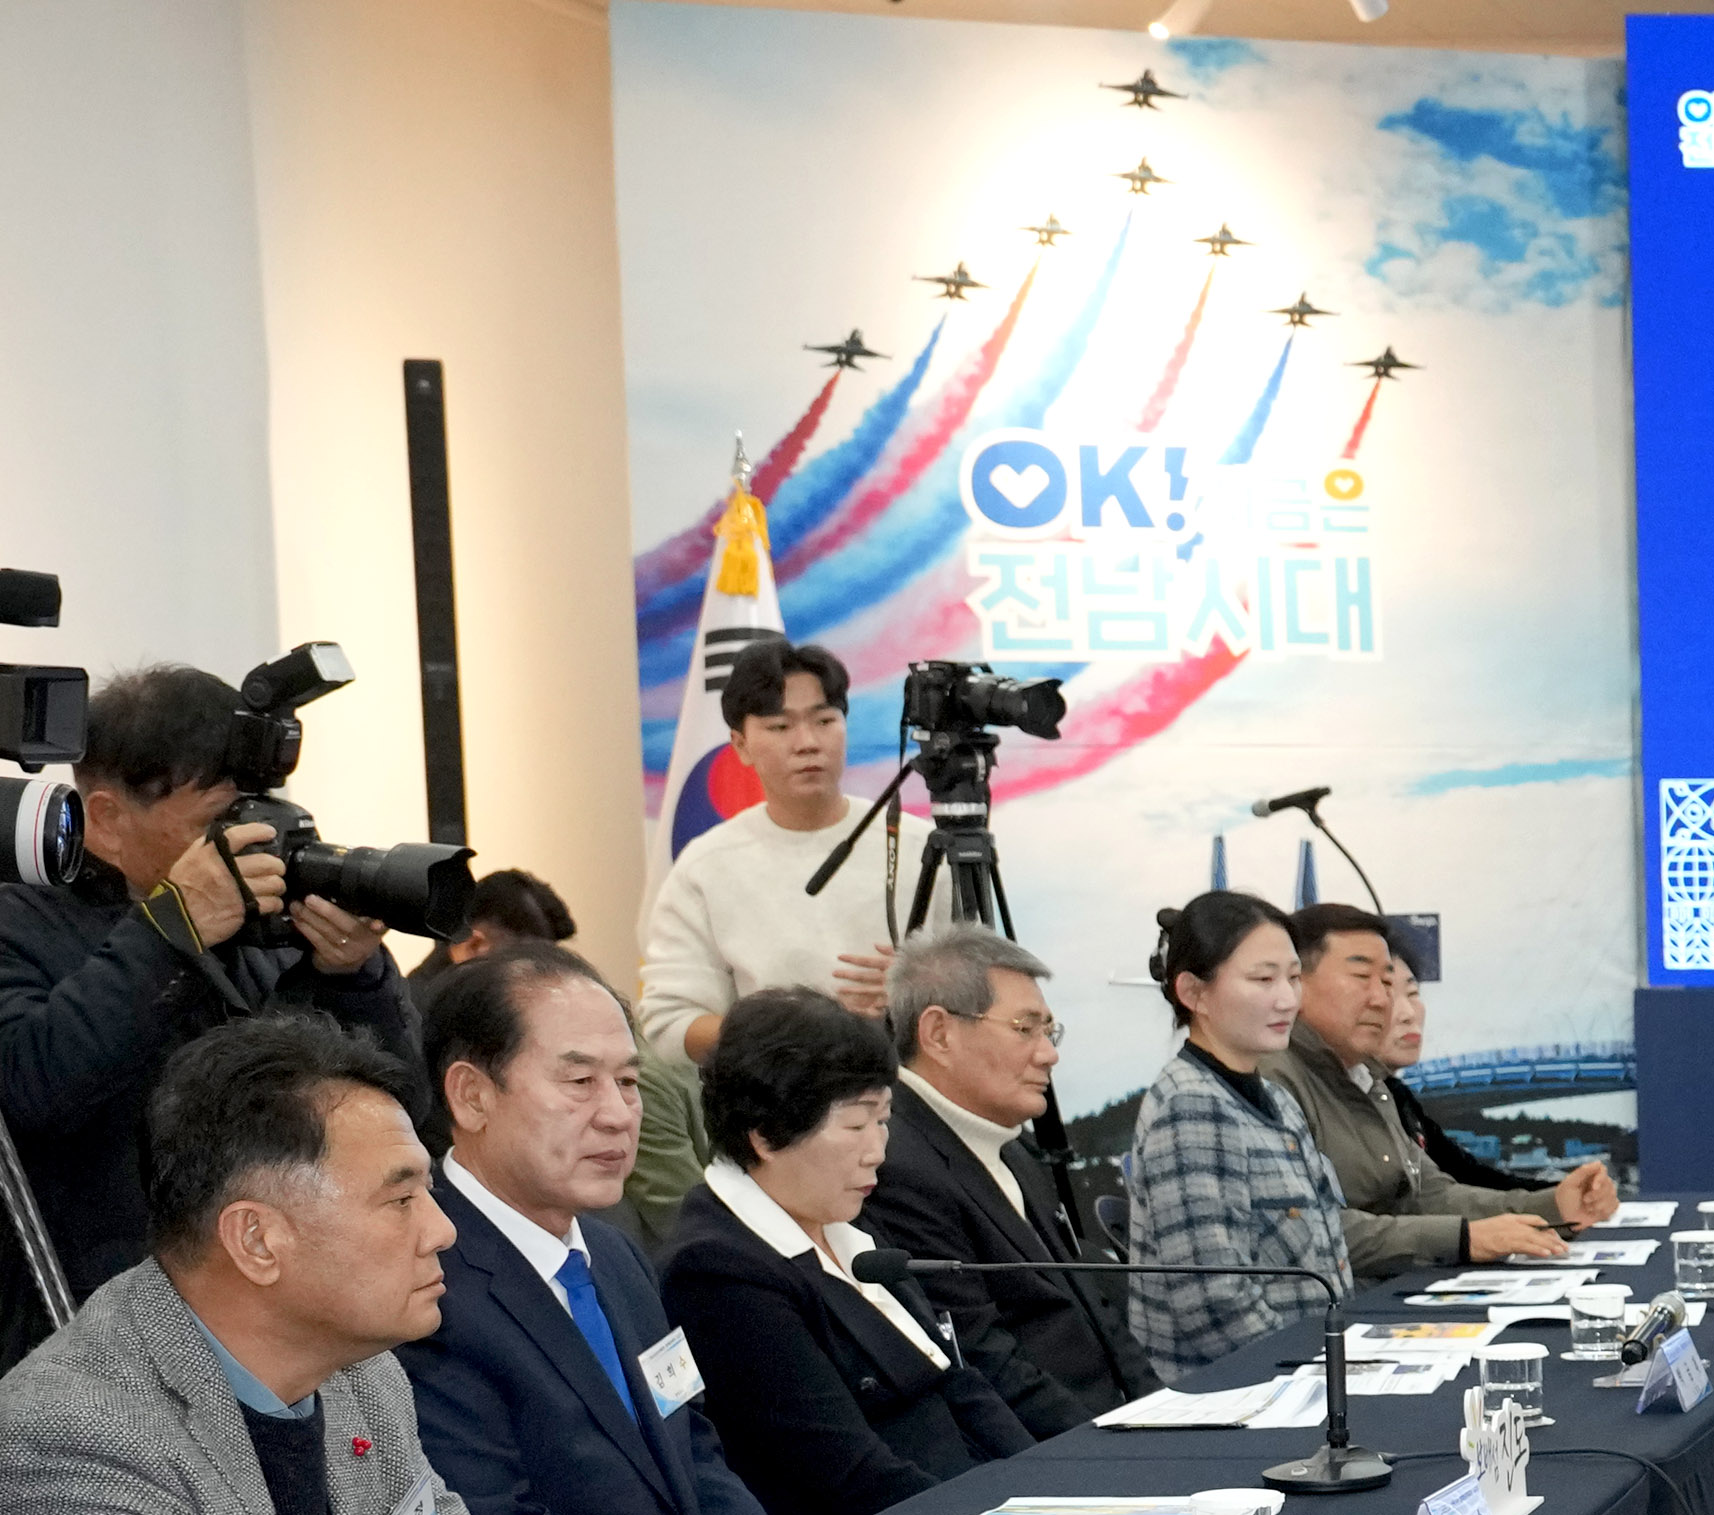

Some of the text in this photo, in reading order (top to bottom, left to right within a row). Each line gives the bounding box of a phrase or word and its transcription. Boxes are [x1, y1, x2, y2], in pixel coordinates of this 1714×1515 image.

[971, 439, 1188, 531] OK!
[977, 554, 1375, 654] 전남시대
[1501, 1408, 1527, 1492] 진도
